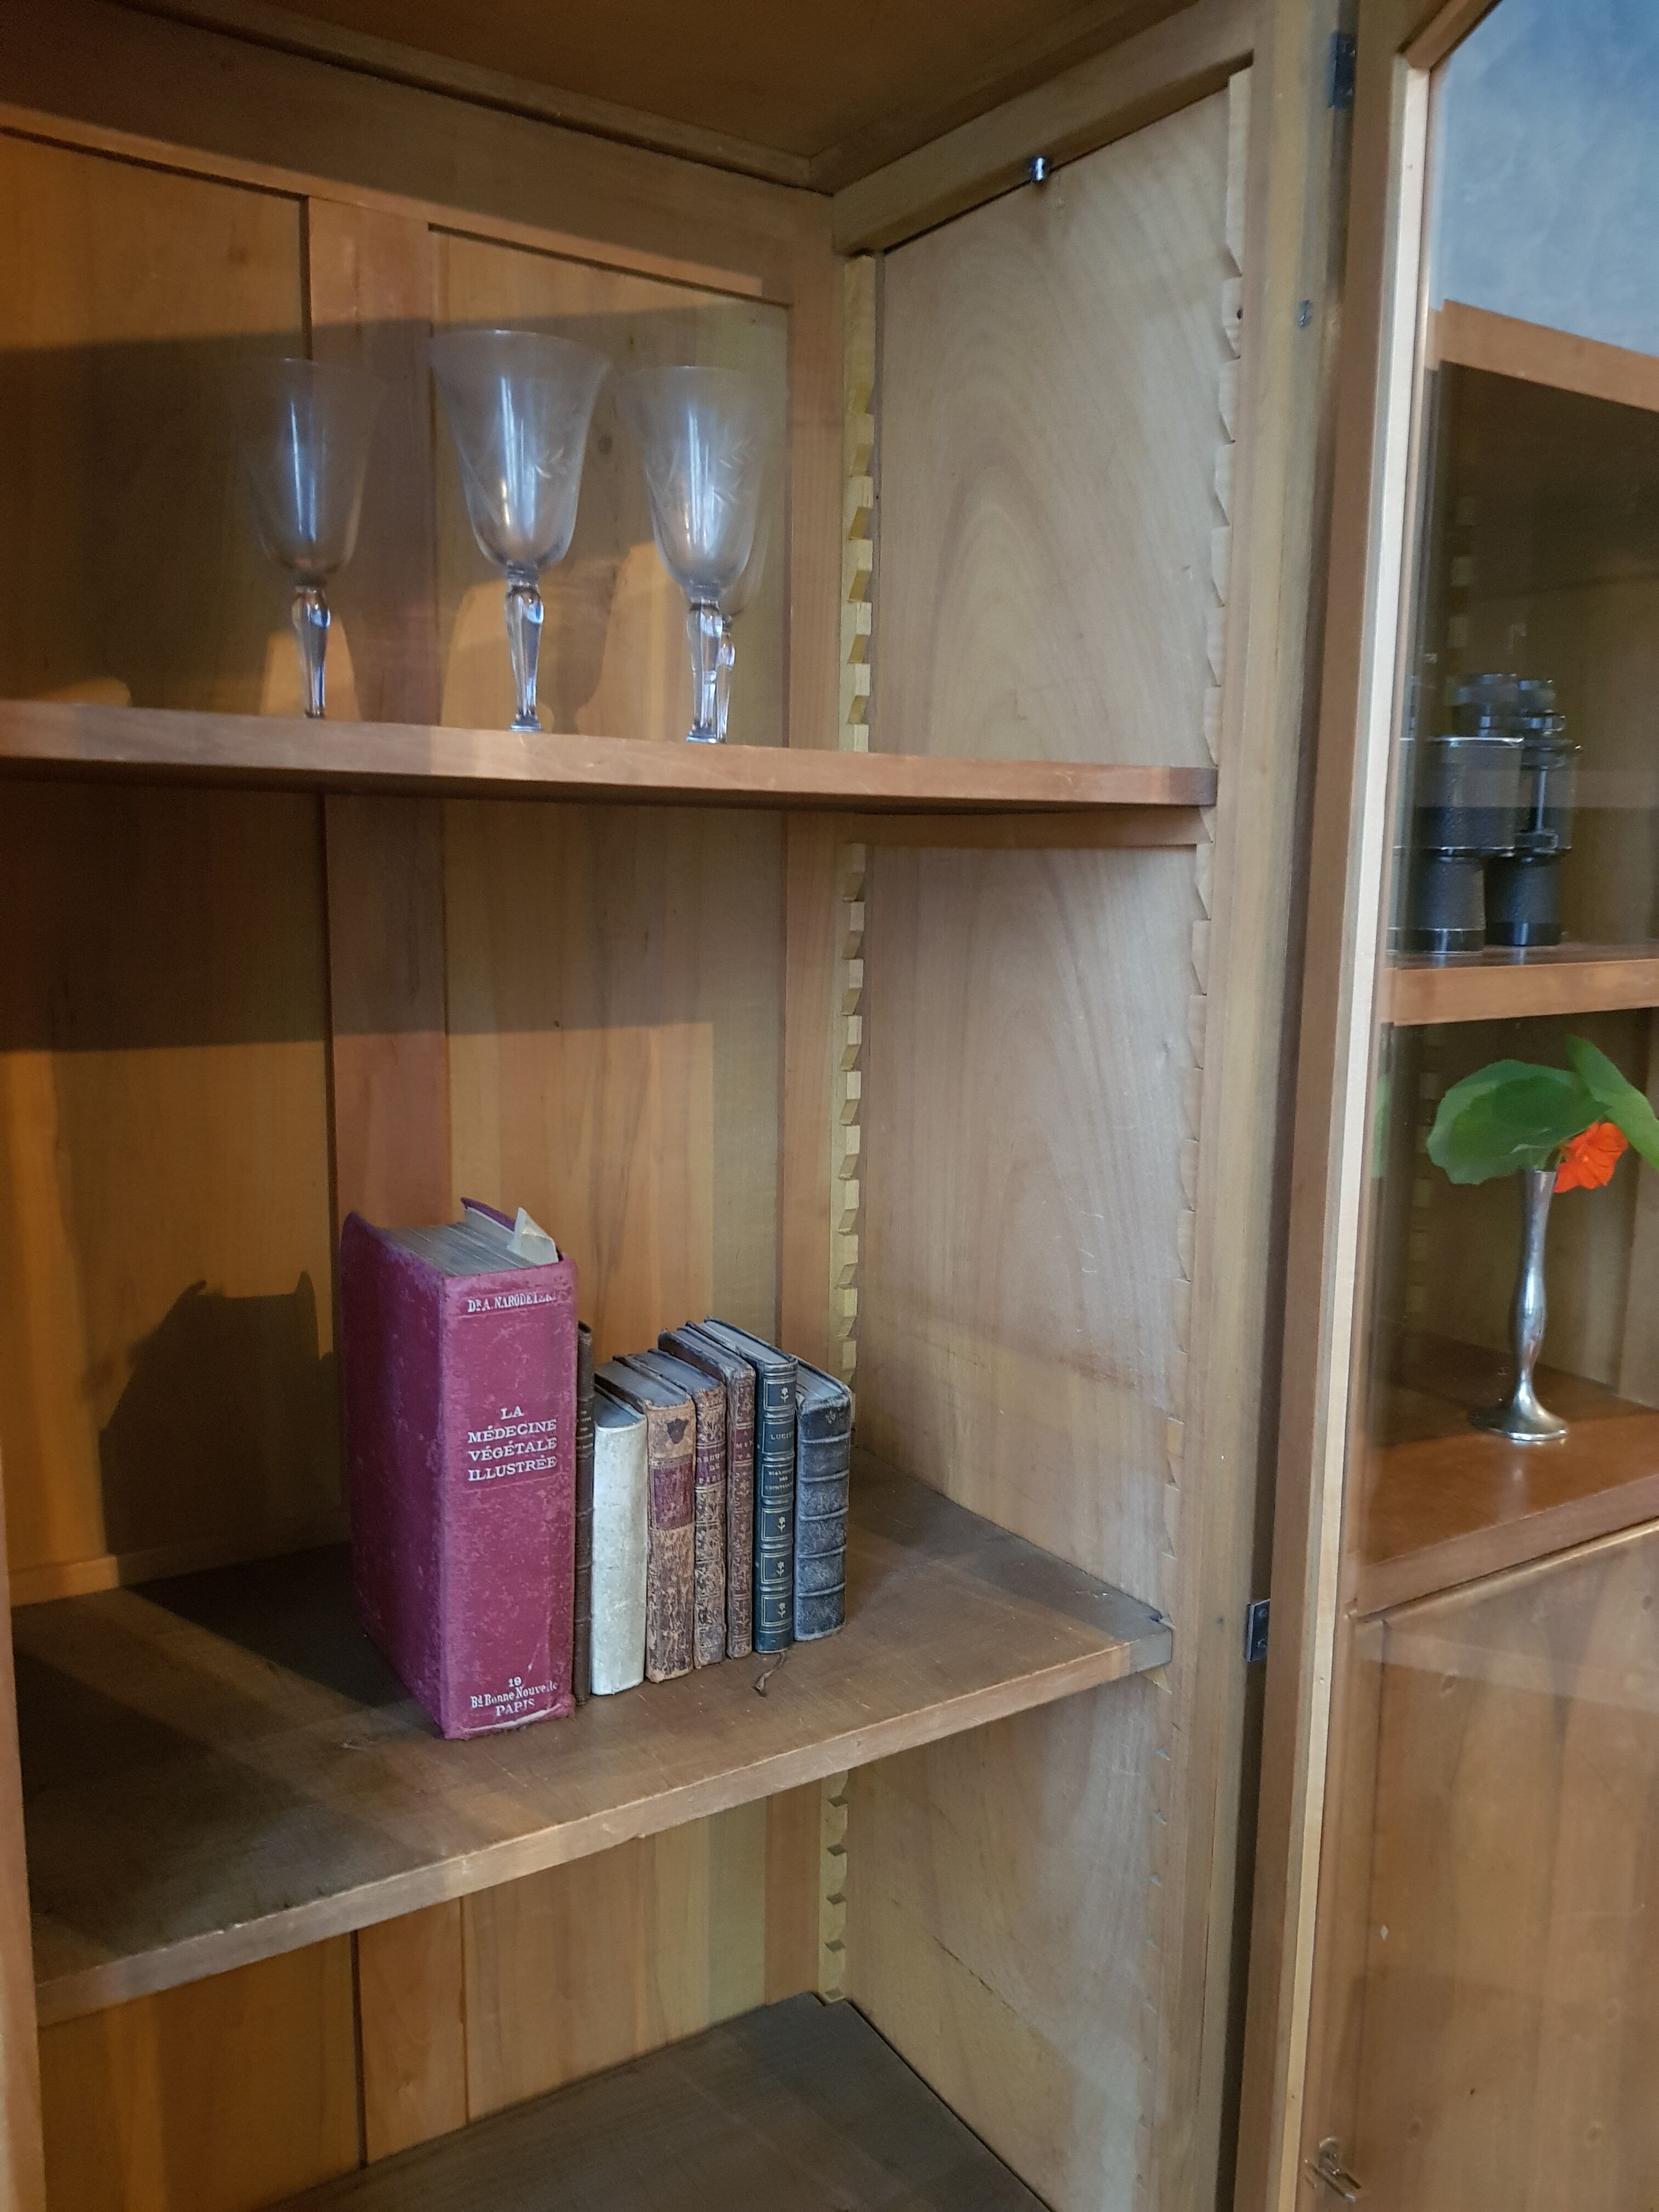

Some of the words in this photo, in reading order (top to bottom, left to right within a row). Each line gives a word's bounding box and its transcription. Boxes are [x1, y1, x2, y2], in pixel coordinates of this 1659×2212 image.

[500, 1406, 524, 1420] LA
[467, 1419, 557, 1443] MÉDECINE
[468, 1437, 557, 1462] VÉGÉTALE
[467, 1455, 557, 1481] ILLUSTRÉE
[484, 1691, 515, 1706] Bonne
[495, 1698, 535, 1717] PARIS
